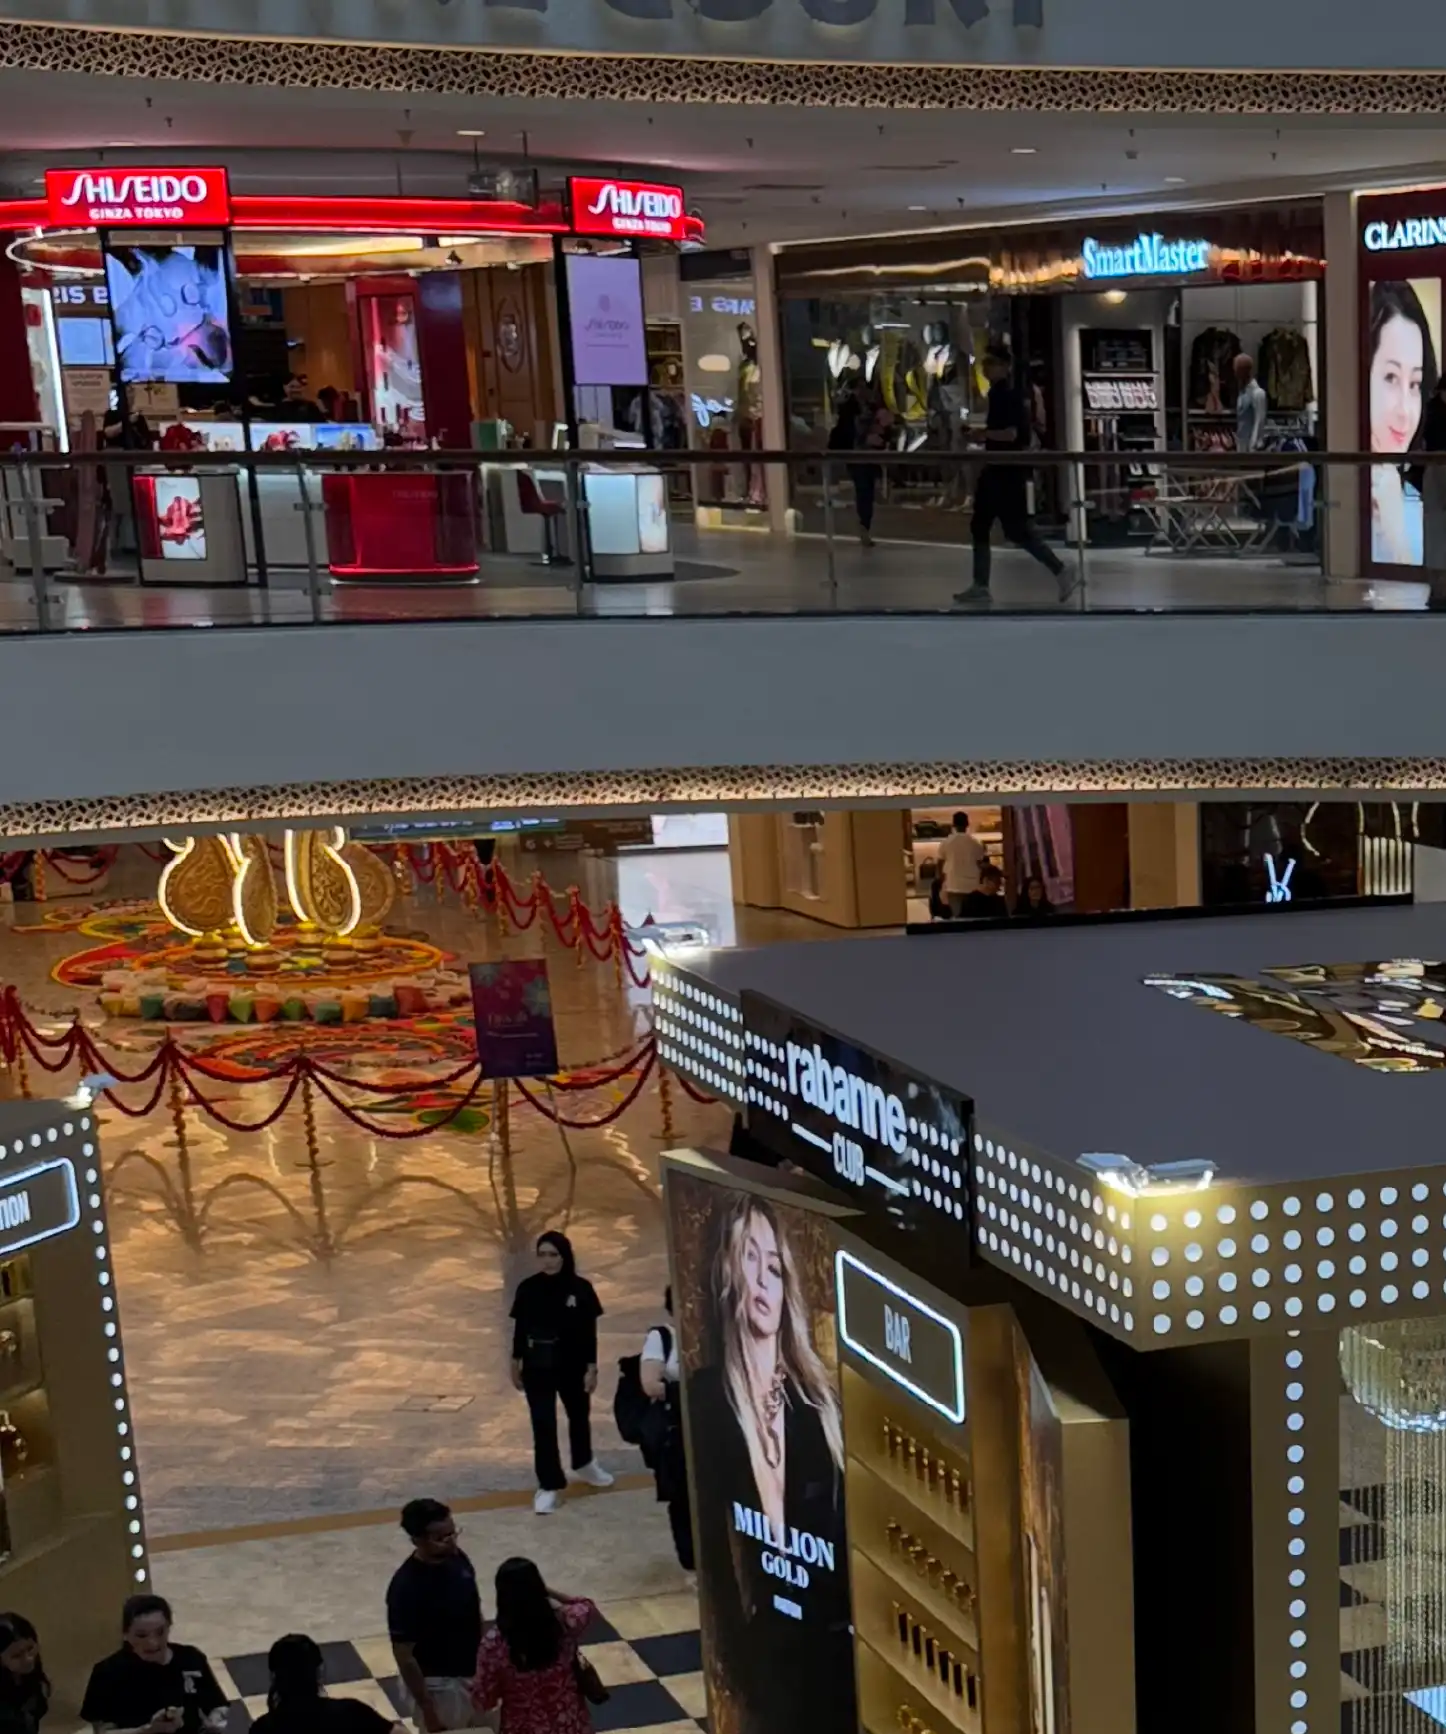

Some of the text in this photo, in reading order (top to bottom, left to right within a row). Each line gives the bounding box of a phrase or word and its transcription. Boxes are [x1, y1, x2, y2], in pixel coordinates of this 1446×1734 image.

[61, 173, 208, 206] SHISEIDO
[89, 207, 185, 220] GINZA TOKYO
[588, 183, 683, 219] SHISEIDO
[1082, 232, 1212, 280] SmartMaster
[785, 1041, 908, 1154] rabanne
[832, 1132, 865, 1187] CLUB
[883, 1303, 912, 1364] BAR
[733, 1502, 836, 1571] MILLION
[761, 1550, 810, 1589] GOLD
